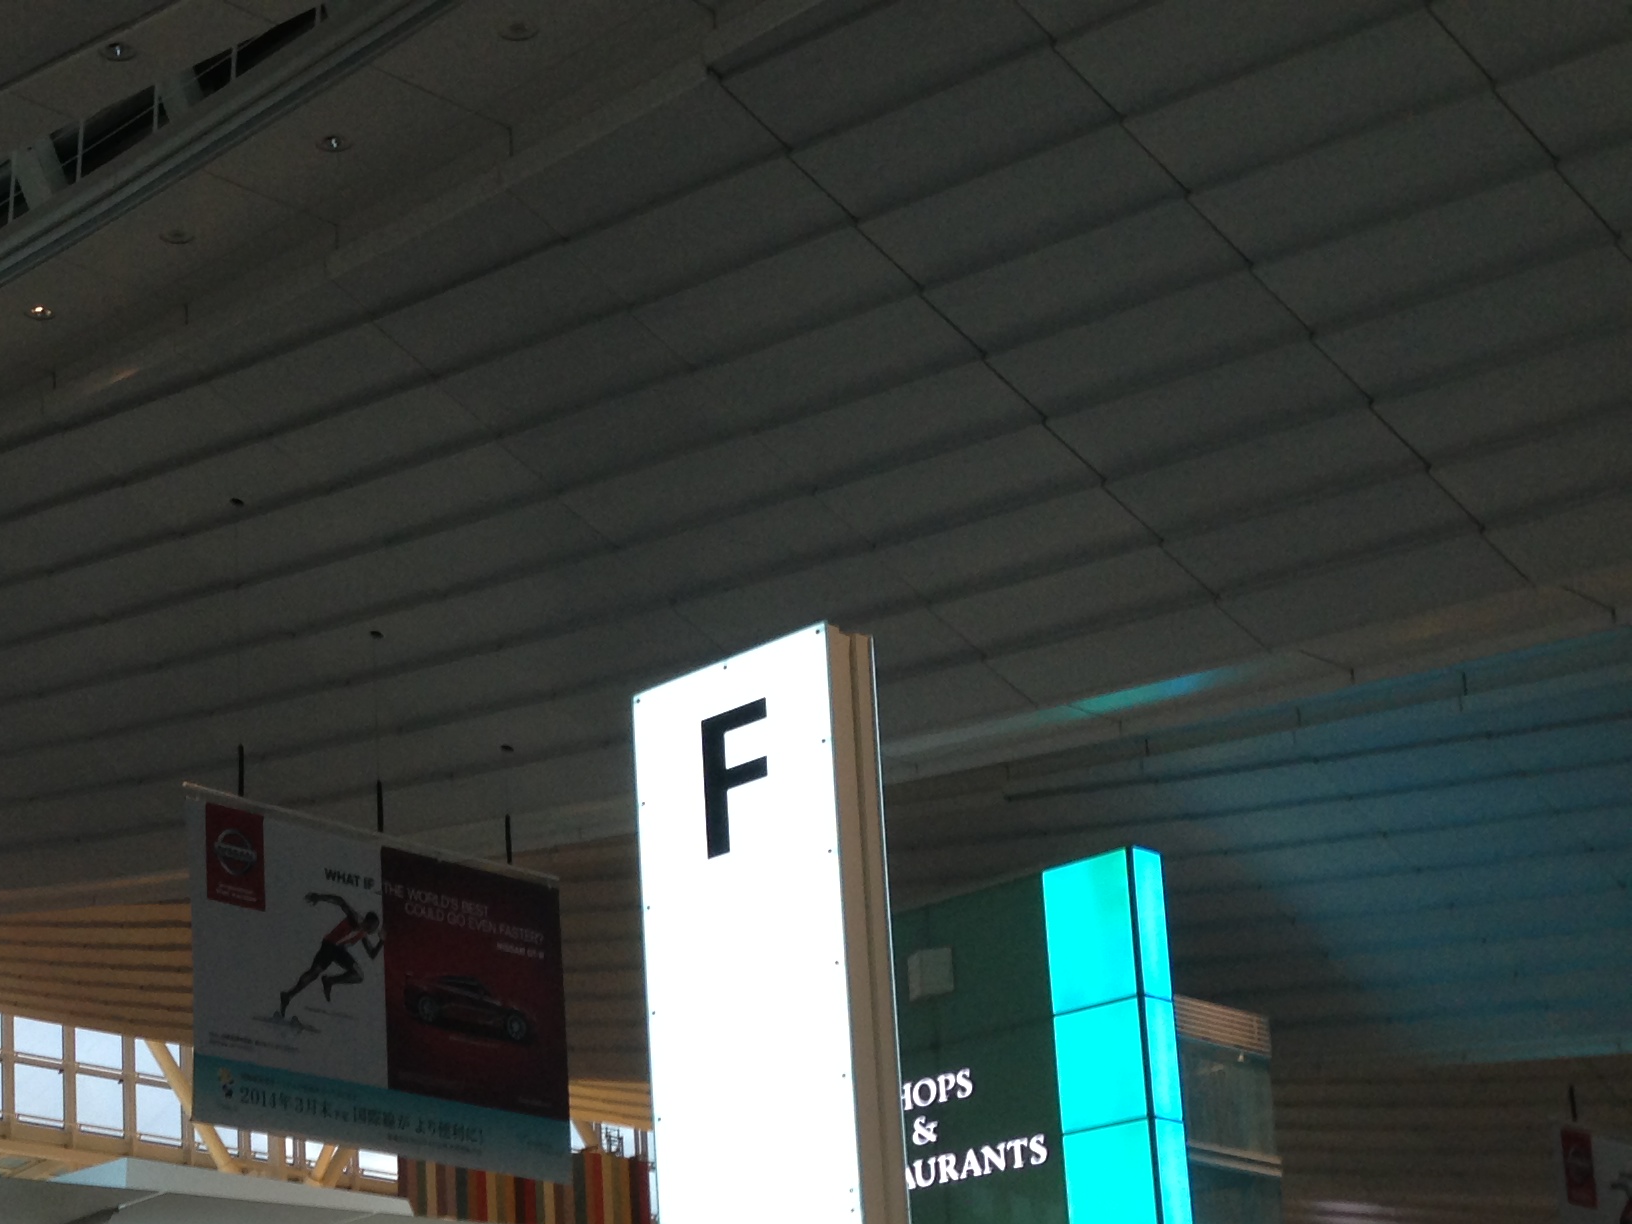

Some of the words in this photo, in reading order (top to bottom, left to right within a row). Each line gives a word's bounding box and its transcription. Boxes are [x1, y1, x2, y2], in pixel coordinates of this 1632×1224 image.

[700, 697, 769, 858] F
[324, 867, 361, 888] WHAT
[383, 881, 405, 900] THE
[406, 888, 459, 912] WORLD'S
[461, 899, 490, 918] BEST
[404, 904, 444, 923] COULD
[447, 913, 466, 927] GO
[468, 916, 497, 935] EVEN
[498, 922, 545, 945] FASTER?
[911, 1115, 939, 1146] &
